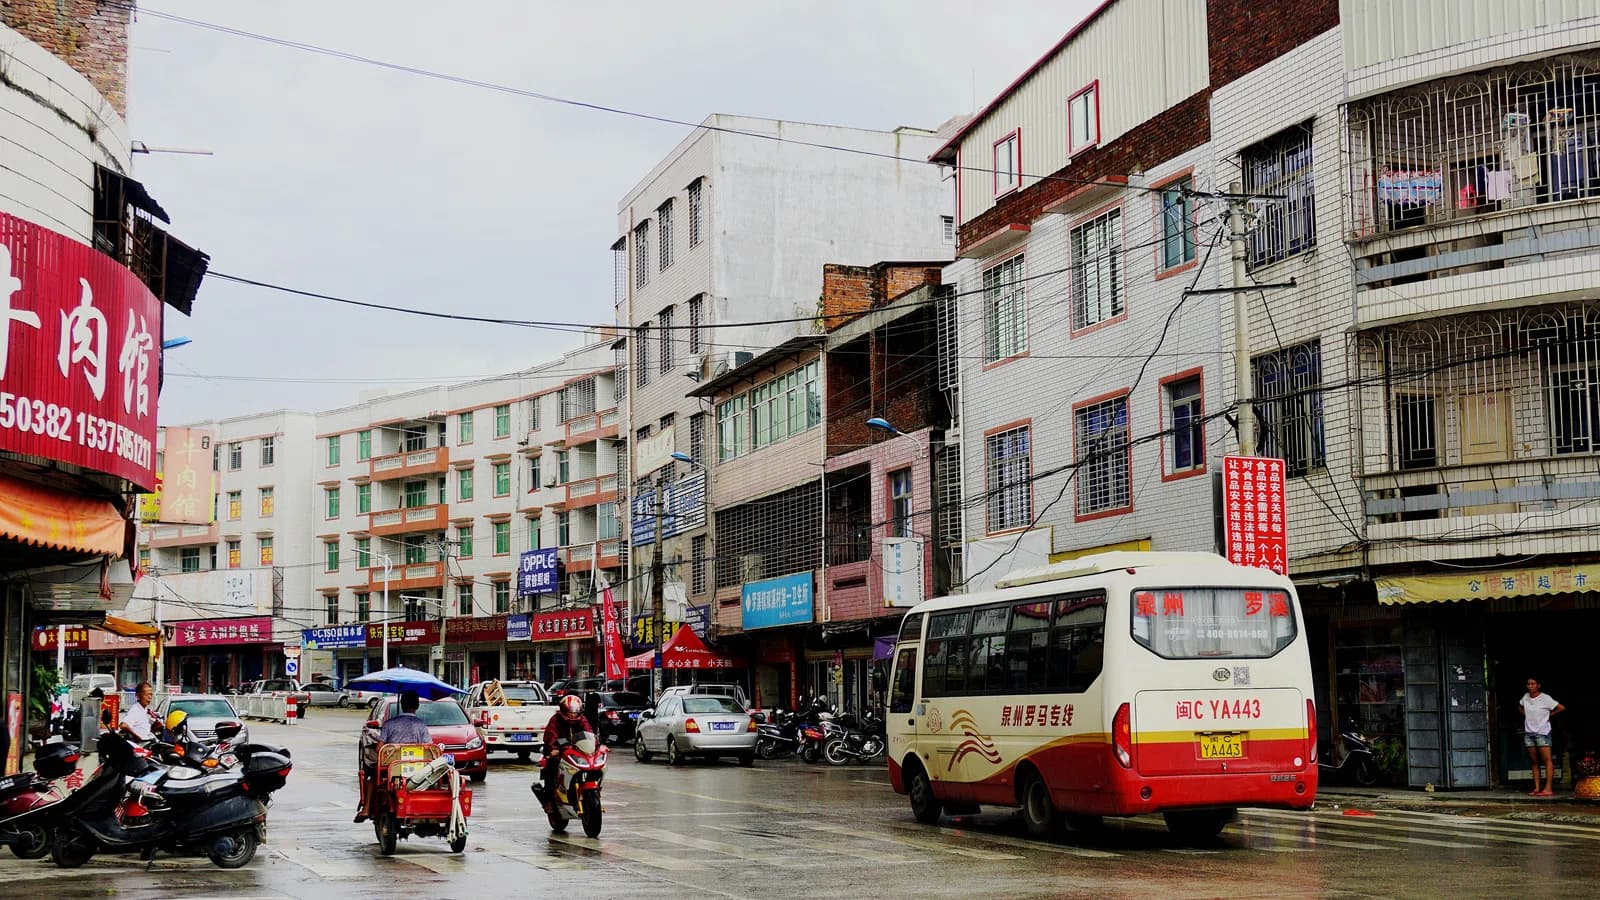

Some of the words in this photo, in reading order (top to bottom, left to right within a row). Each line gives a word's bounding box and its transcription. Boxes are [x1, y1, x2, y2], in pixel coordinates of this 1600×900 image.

[1228, 460, 1242, 567] 让食品安全违法违规者
[1242, 461, 1256, 567] 对食品安全违法违规行
[524, 553, 555, 572] OPPLE
[1136, 592, 1184, 617] 泉州
[1244, 592, 1289, 617] 罗溪
[1001, 704, 1074, 727] 泉州罗马专线
[1176, 701, 1204, 720] 闽C
[1209, 698, 1261, 720] YA443
[1203, 743, 1241, 756] YA443
